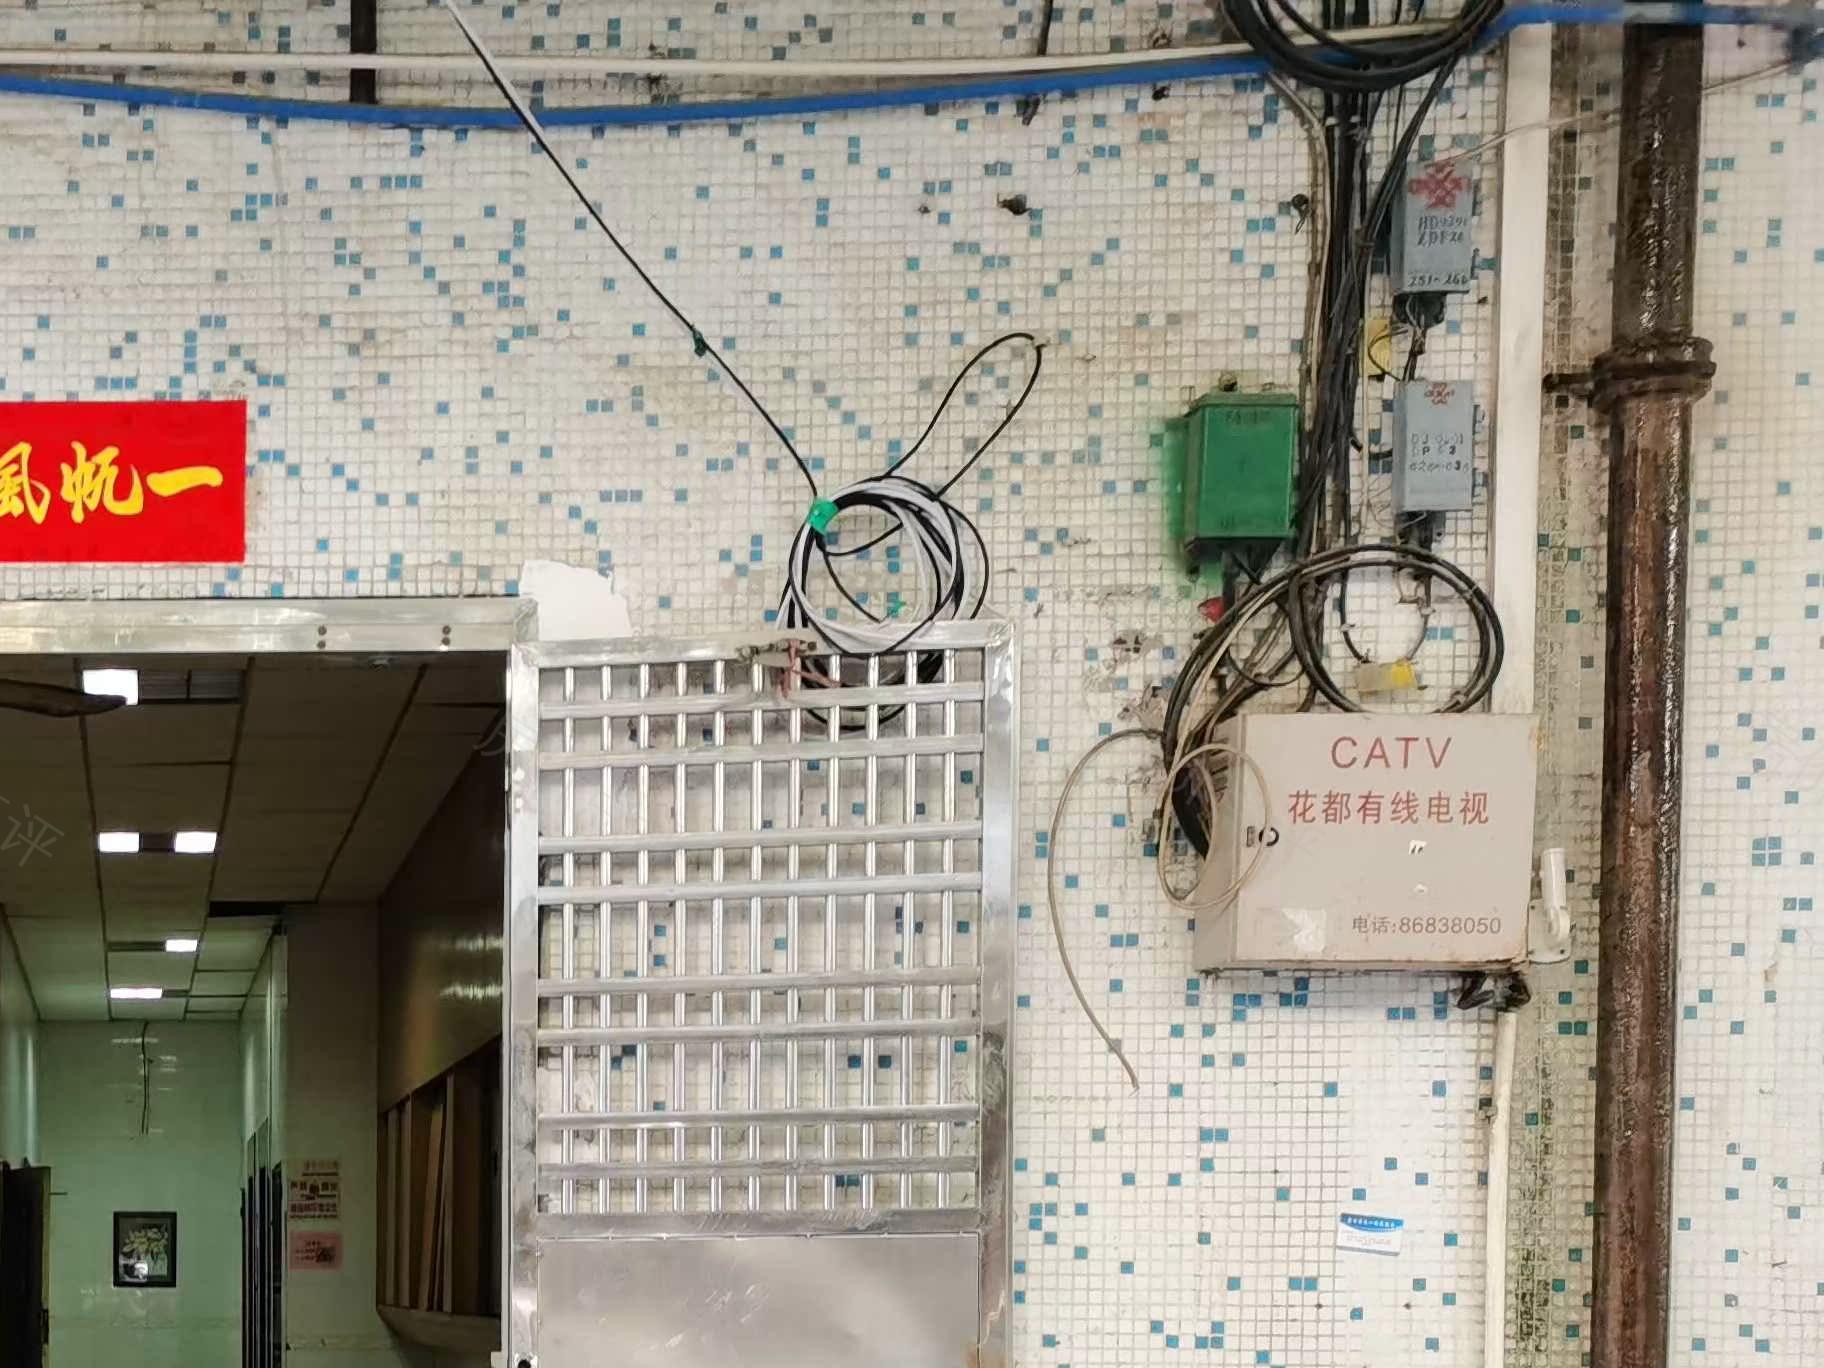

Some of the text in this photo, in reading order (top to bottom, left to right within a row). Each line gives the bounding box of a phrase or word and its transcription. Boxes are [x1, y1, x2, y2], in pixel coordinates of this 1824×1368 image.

[1330, 735, 1453, 769] CATV
[1288, 790, 1490, 825] 花都有线电视
